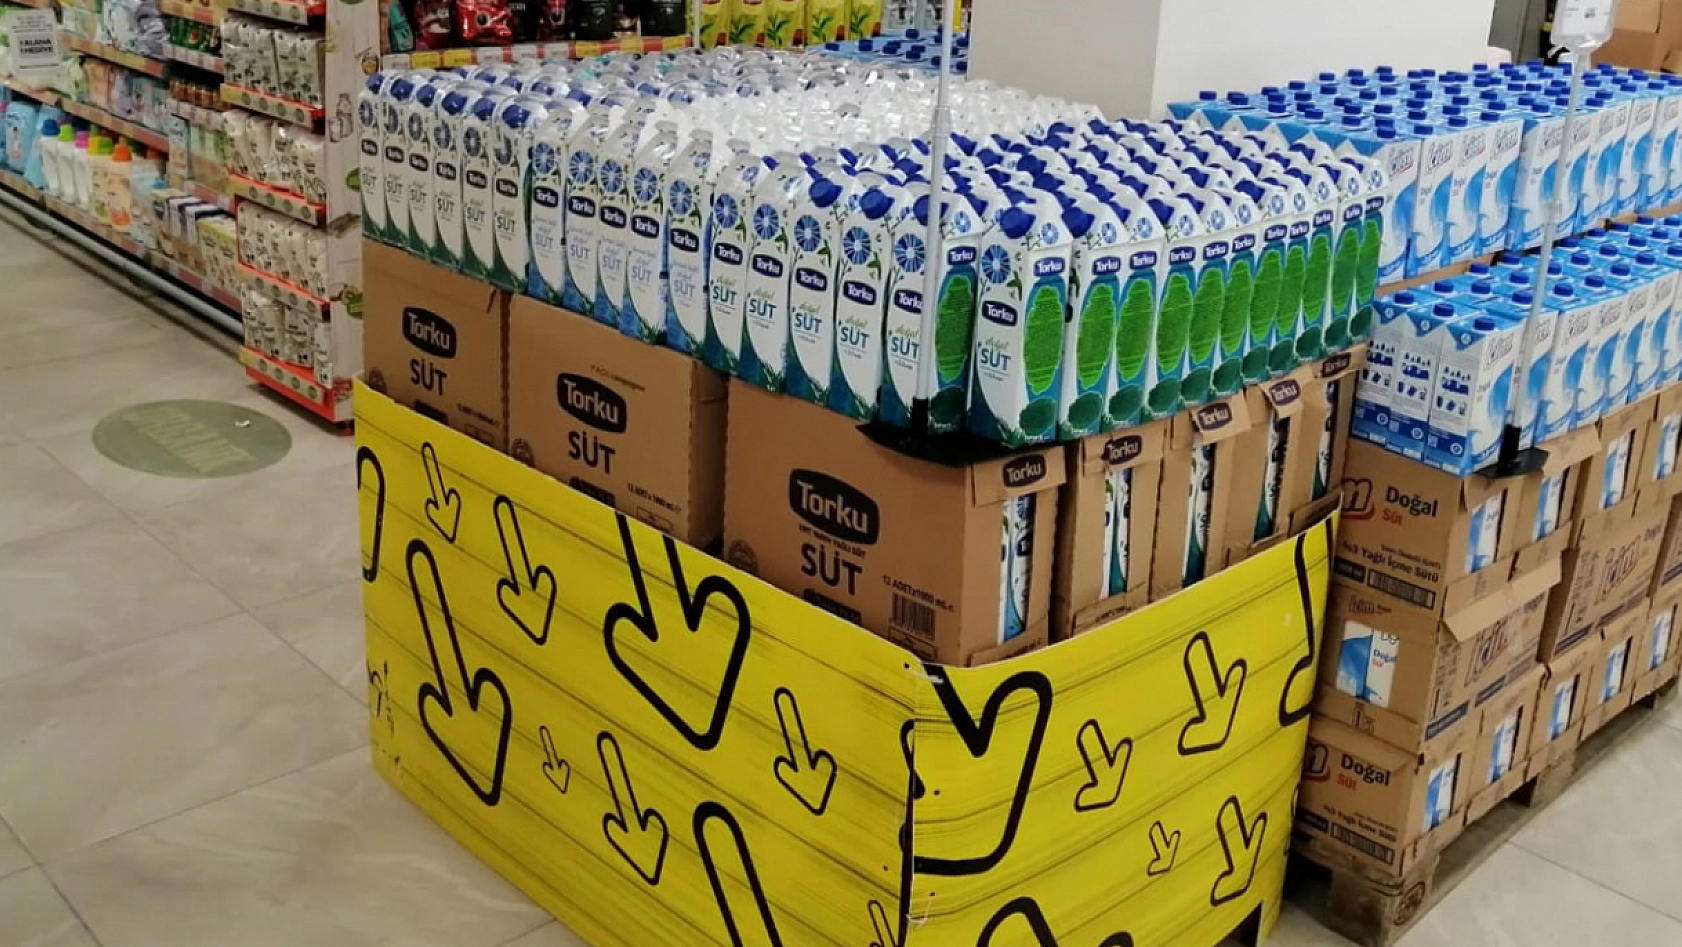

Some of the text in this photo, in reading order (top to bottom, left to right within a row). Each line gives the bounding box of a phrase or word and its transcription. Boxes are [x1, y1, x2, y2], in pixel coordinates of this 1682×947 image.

[536, 190, 557, 204] Torku
[571, 200, 595, 214] Torku
[603, 210, 625, 225] Torku
[634, 219, 658, 235] Torku
[673, 232, 697, 248] Torku
[717, 246, 741, 263] Torku
[949, 250, 974, 262] Torku
[1133, 255, 1155, 267] Torku
[1171, 249, 1193, 262] Torku
[756, 258, 780, 275] Torku
[1037, 261, 1063, 275] Torku
[1095, 261, 1119, 273] Torku
[800, 272, 825, 289] Torku
[847, 284, 874, 303] Torku
[986, 303, 1015, 324] Torku
[407, 310, 451, 349] Torku
[409, 358, 448, 397] SÜT
[562, 378, 619, 425] Torku
[1200, 407, 1230, 426] Torku
[568, 430, 616, 474] SÜT
[1007, 461, 1042, 484] Torku
[796, 479, 870, 535] Torku
[1385, 485, 1439, 518] Doğal
[800, 541, 863, 596] SÜT
[1341, 753, 1391, 787] Doğal
